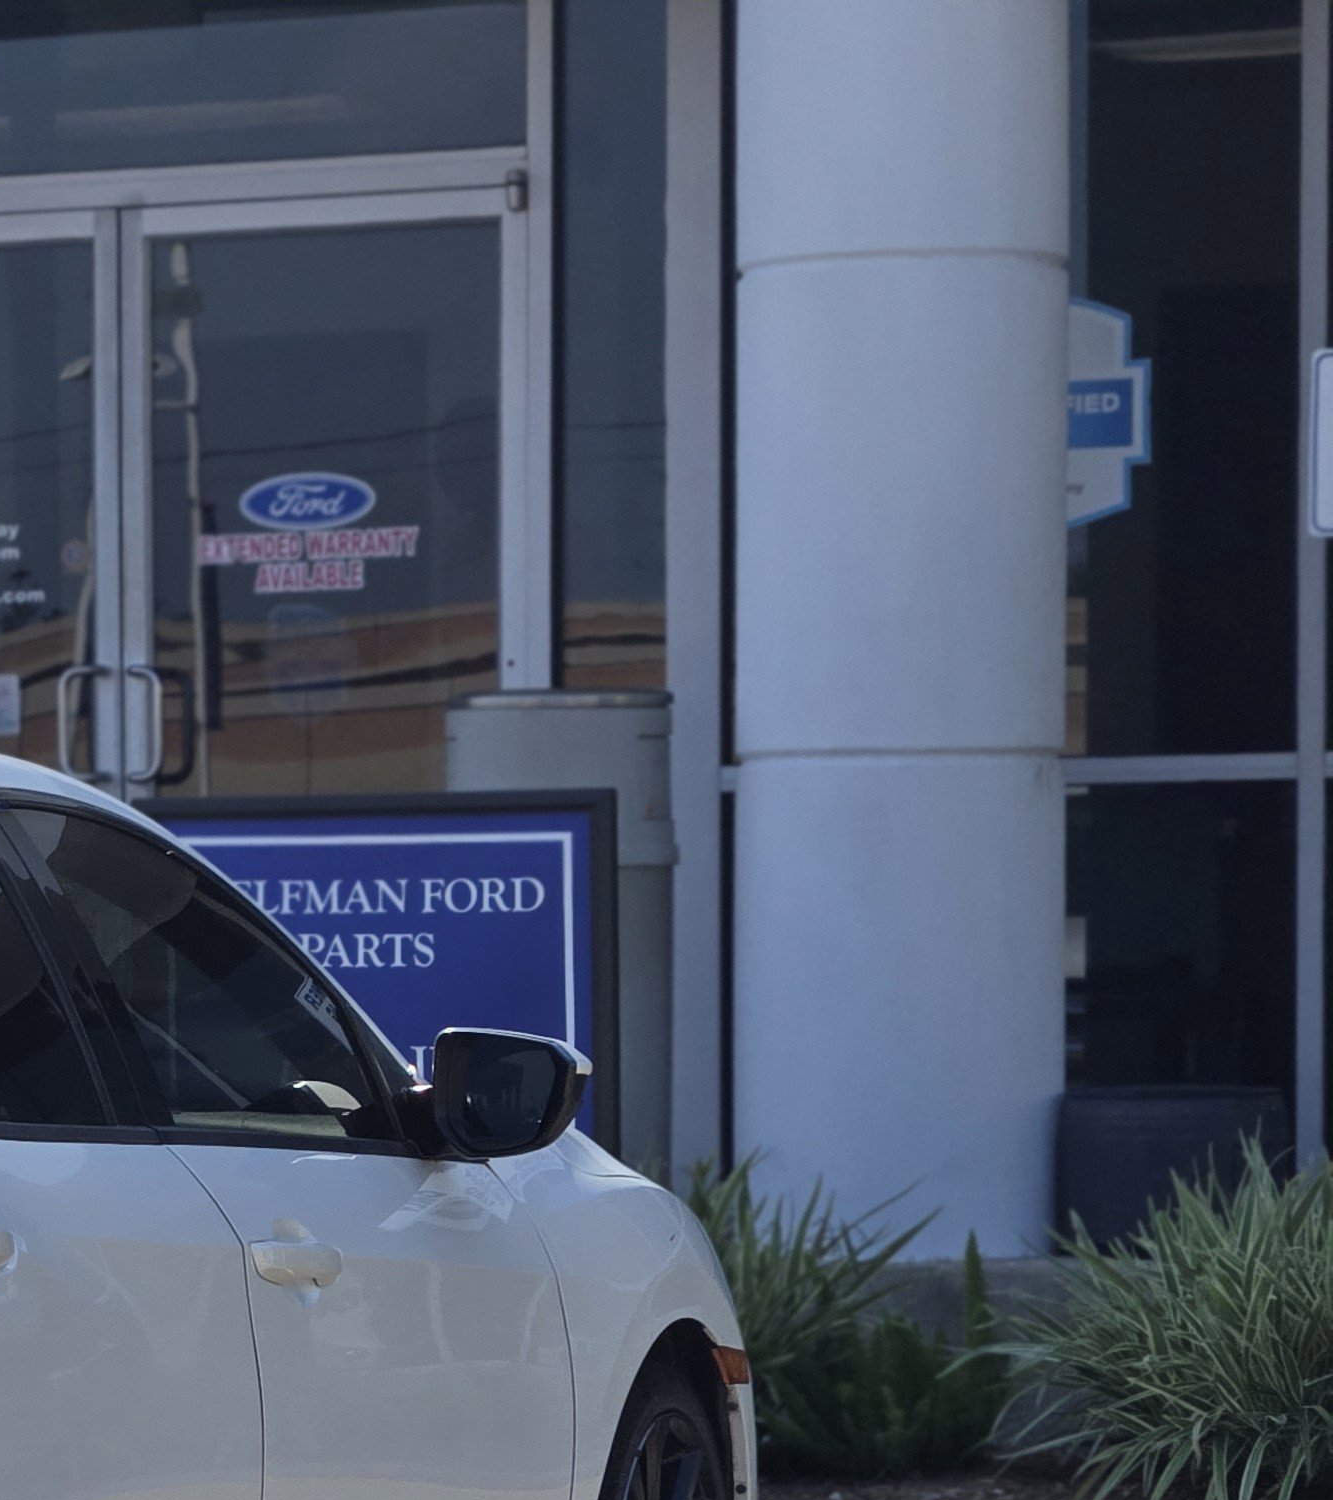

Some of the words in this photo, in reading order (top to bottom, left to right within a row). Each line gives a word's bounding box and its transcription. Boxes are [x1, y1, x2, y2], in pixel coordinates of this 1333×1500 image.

[268, 485, 347, 517] Ford
[199, 534, 302, 565] EXTENDED
[304, 527, 420, 560] WARRANTY
[254, 560, 365, 594] AVAILABLE
[421, 876, 545, 914] FORD
[297, 932, 435, 968] PARTS
